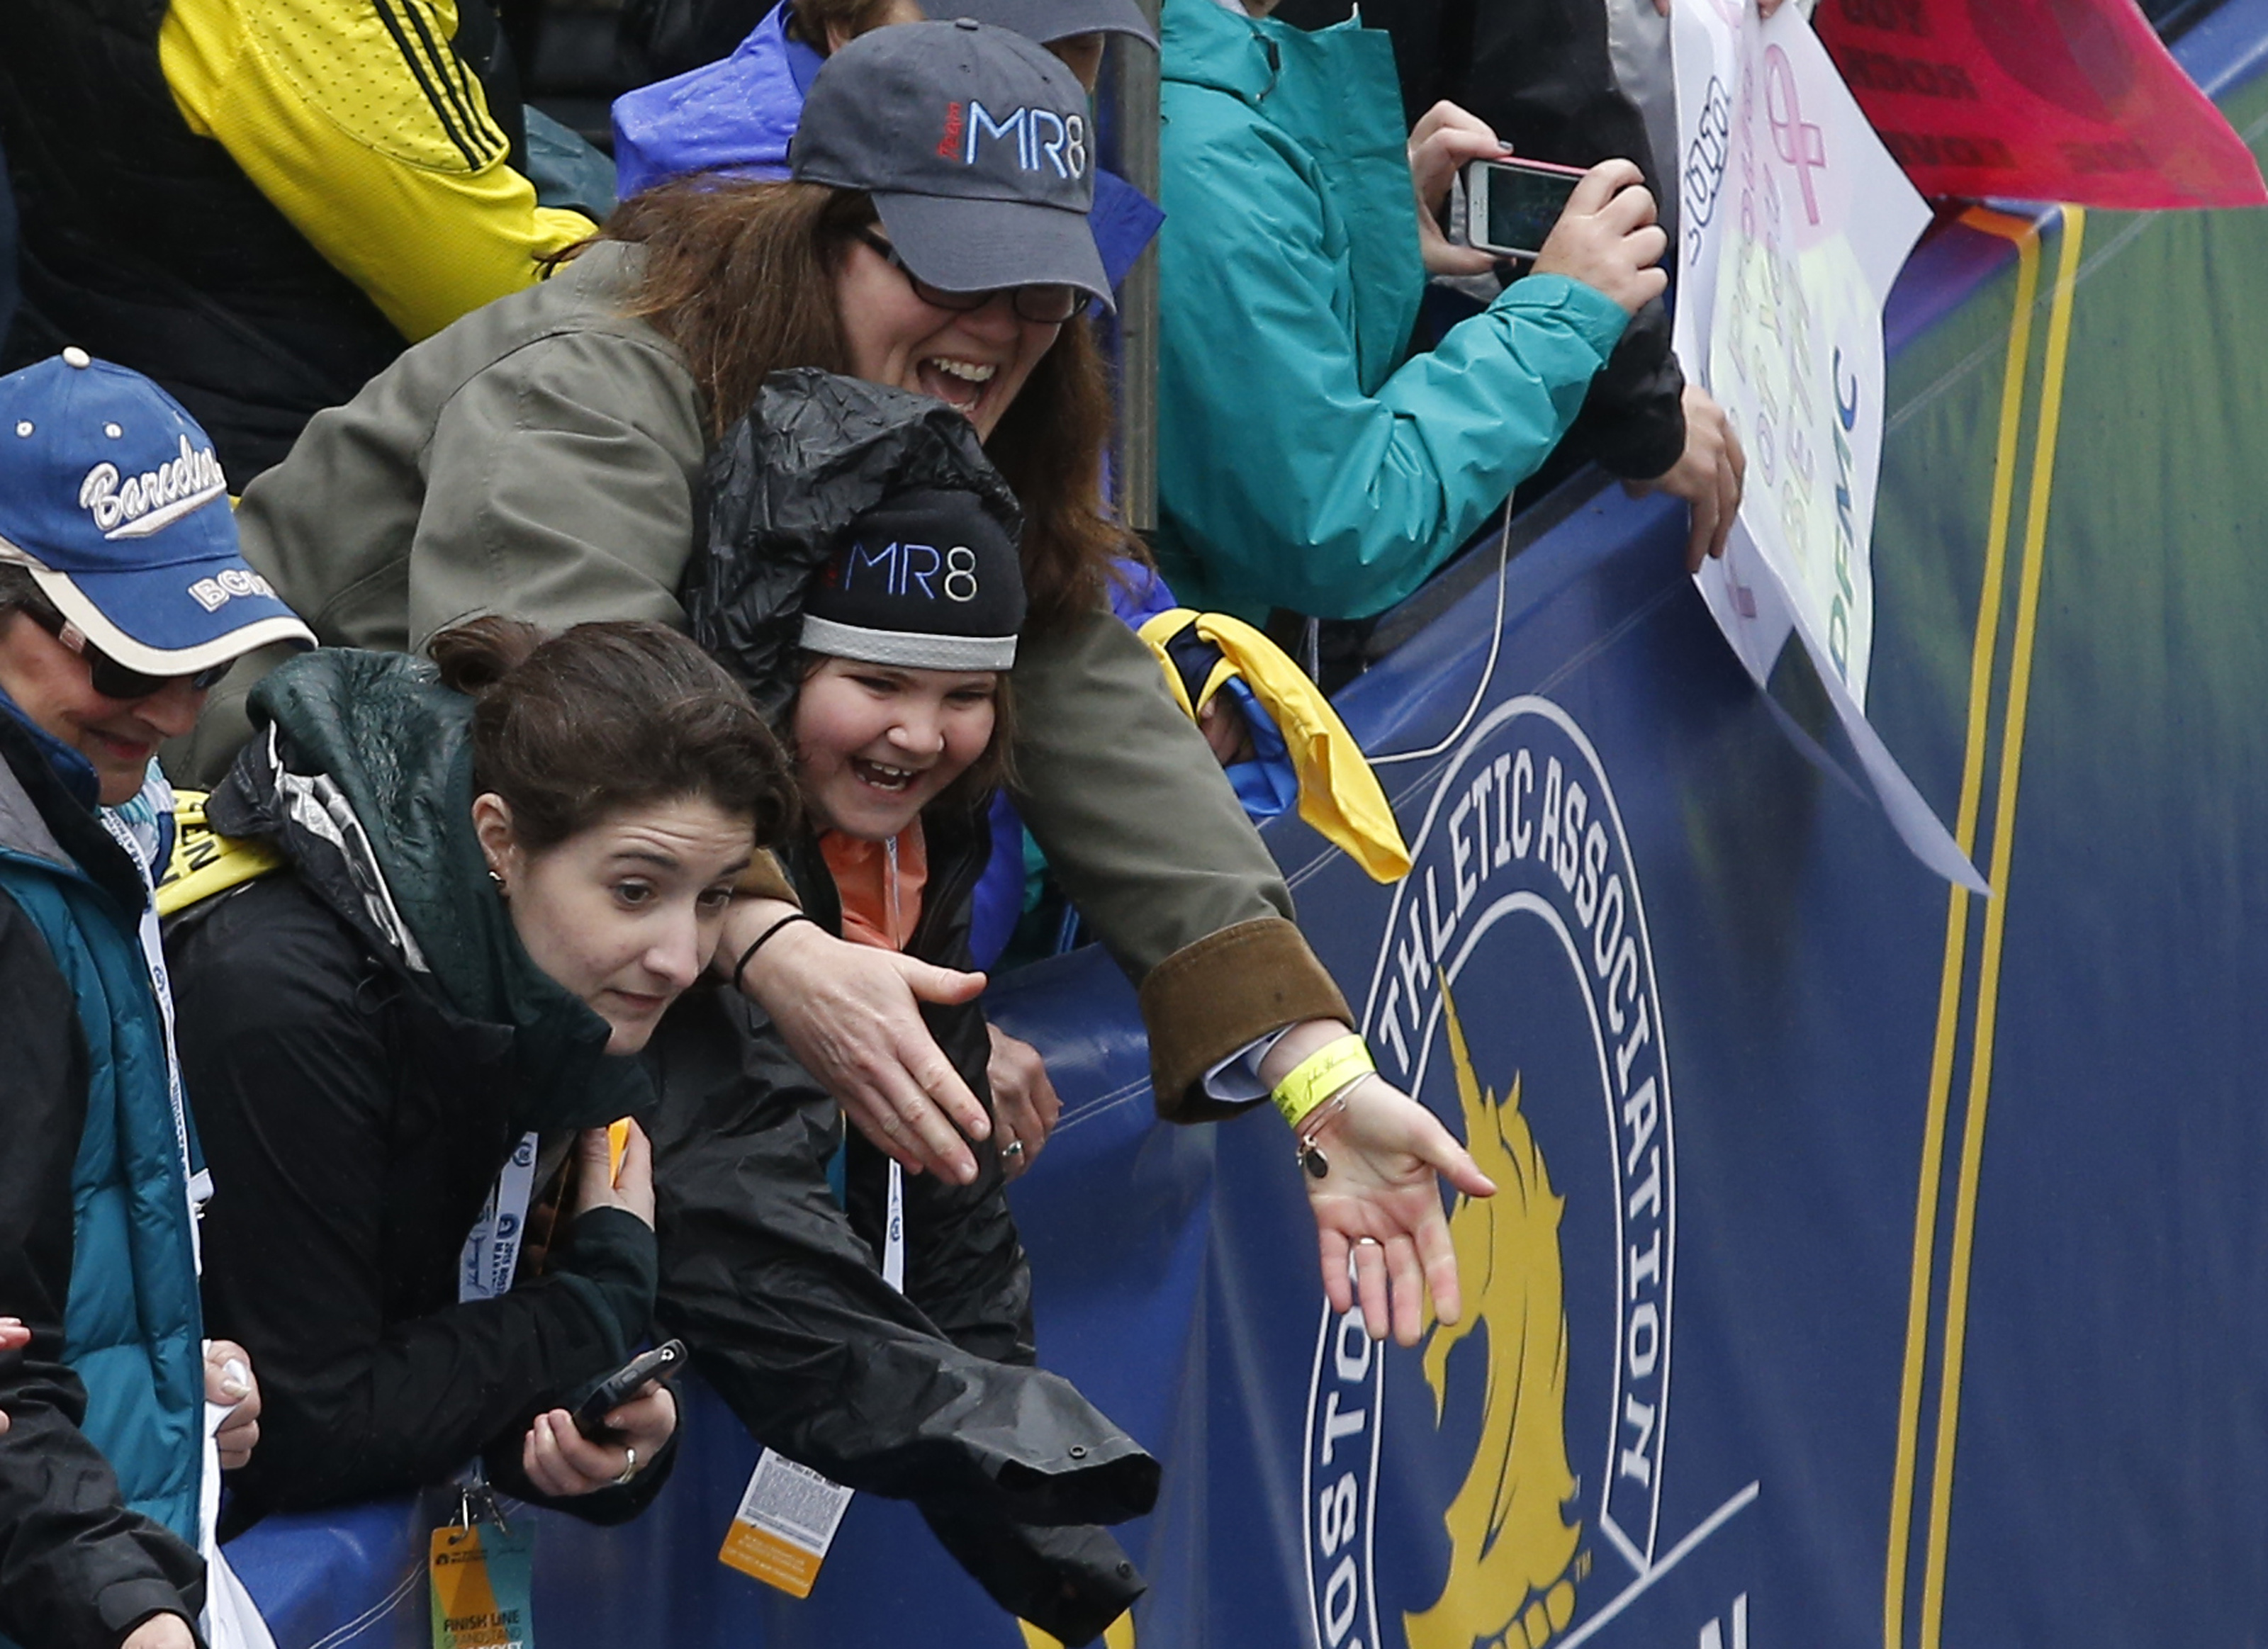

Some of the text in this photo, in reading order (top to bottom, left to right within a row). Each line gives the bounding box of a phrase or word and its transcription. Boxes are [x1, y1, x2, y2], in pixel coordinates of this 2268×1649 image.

[966, 99, 1087, 179] MR8
[846, 541, 977, 602] MR8
[1830, 346, 1858, 687] DFMC
[1379, 748, 1534, 1076] THLETIC
[1539, 755, 1661, 1487] ASSOCIATION
